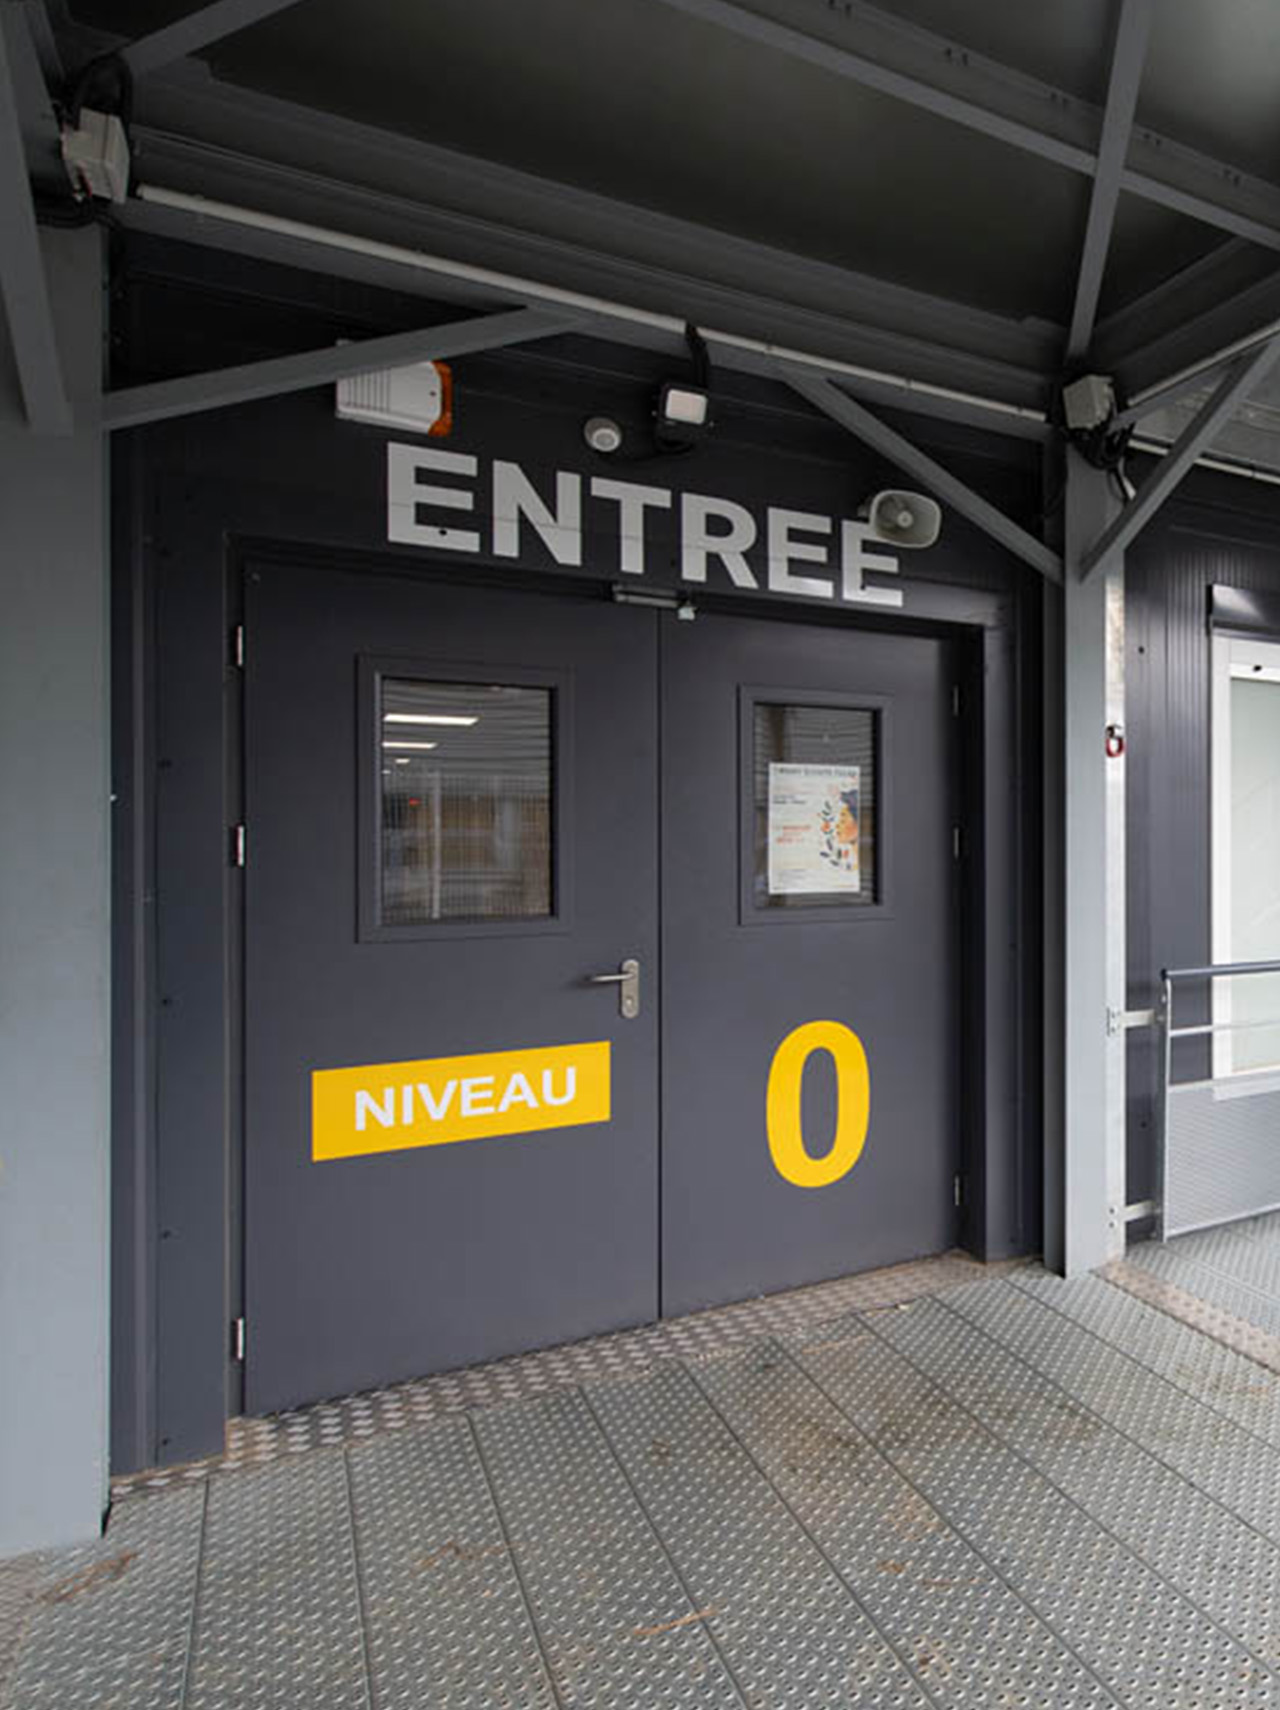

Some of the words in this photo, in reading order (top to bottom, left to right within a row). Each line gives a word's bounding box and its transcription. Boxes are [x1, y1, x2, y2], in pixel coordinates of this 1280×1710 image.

[387, 442, 904, 607] ENTREE
[354, 1066, 578, 1131] NIVEAU
[766, 1020, 870, 1188] 0
